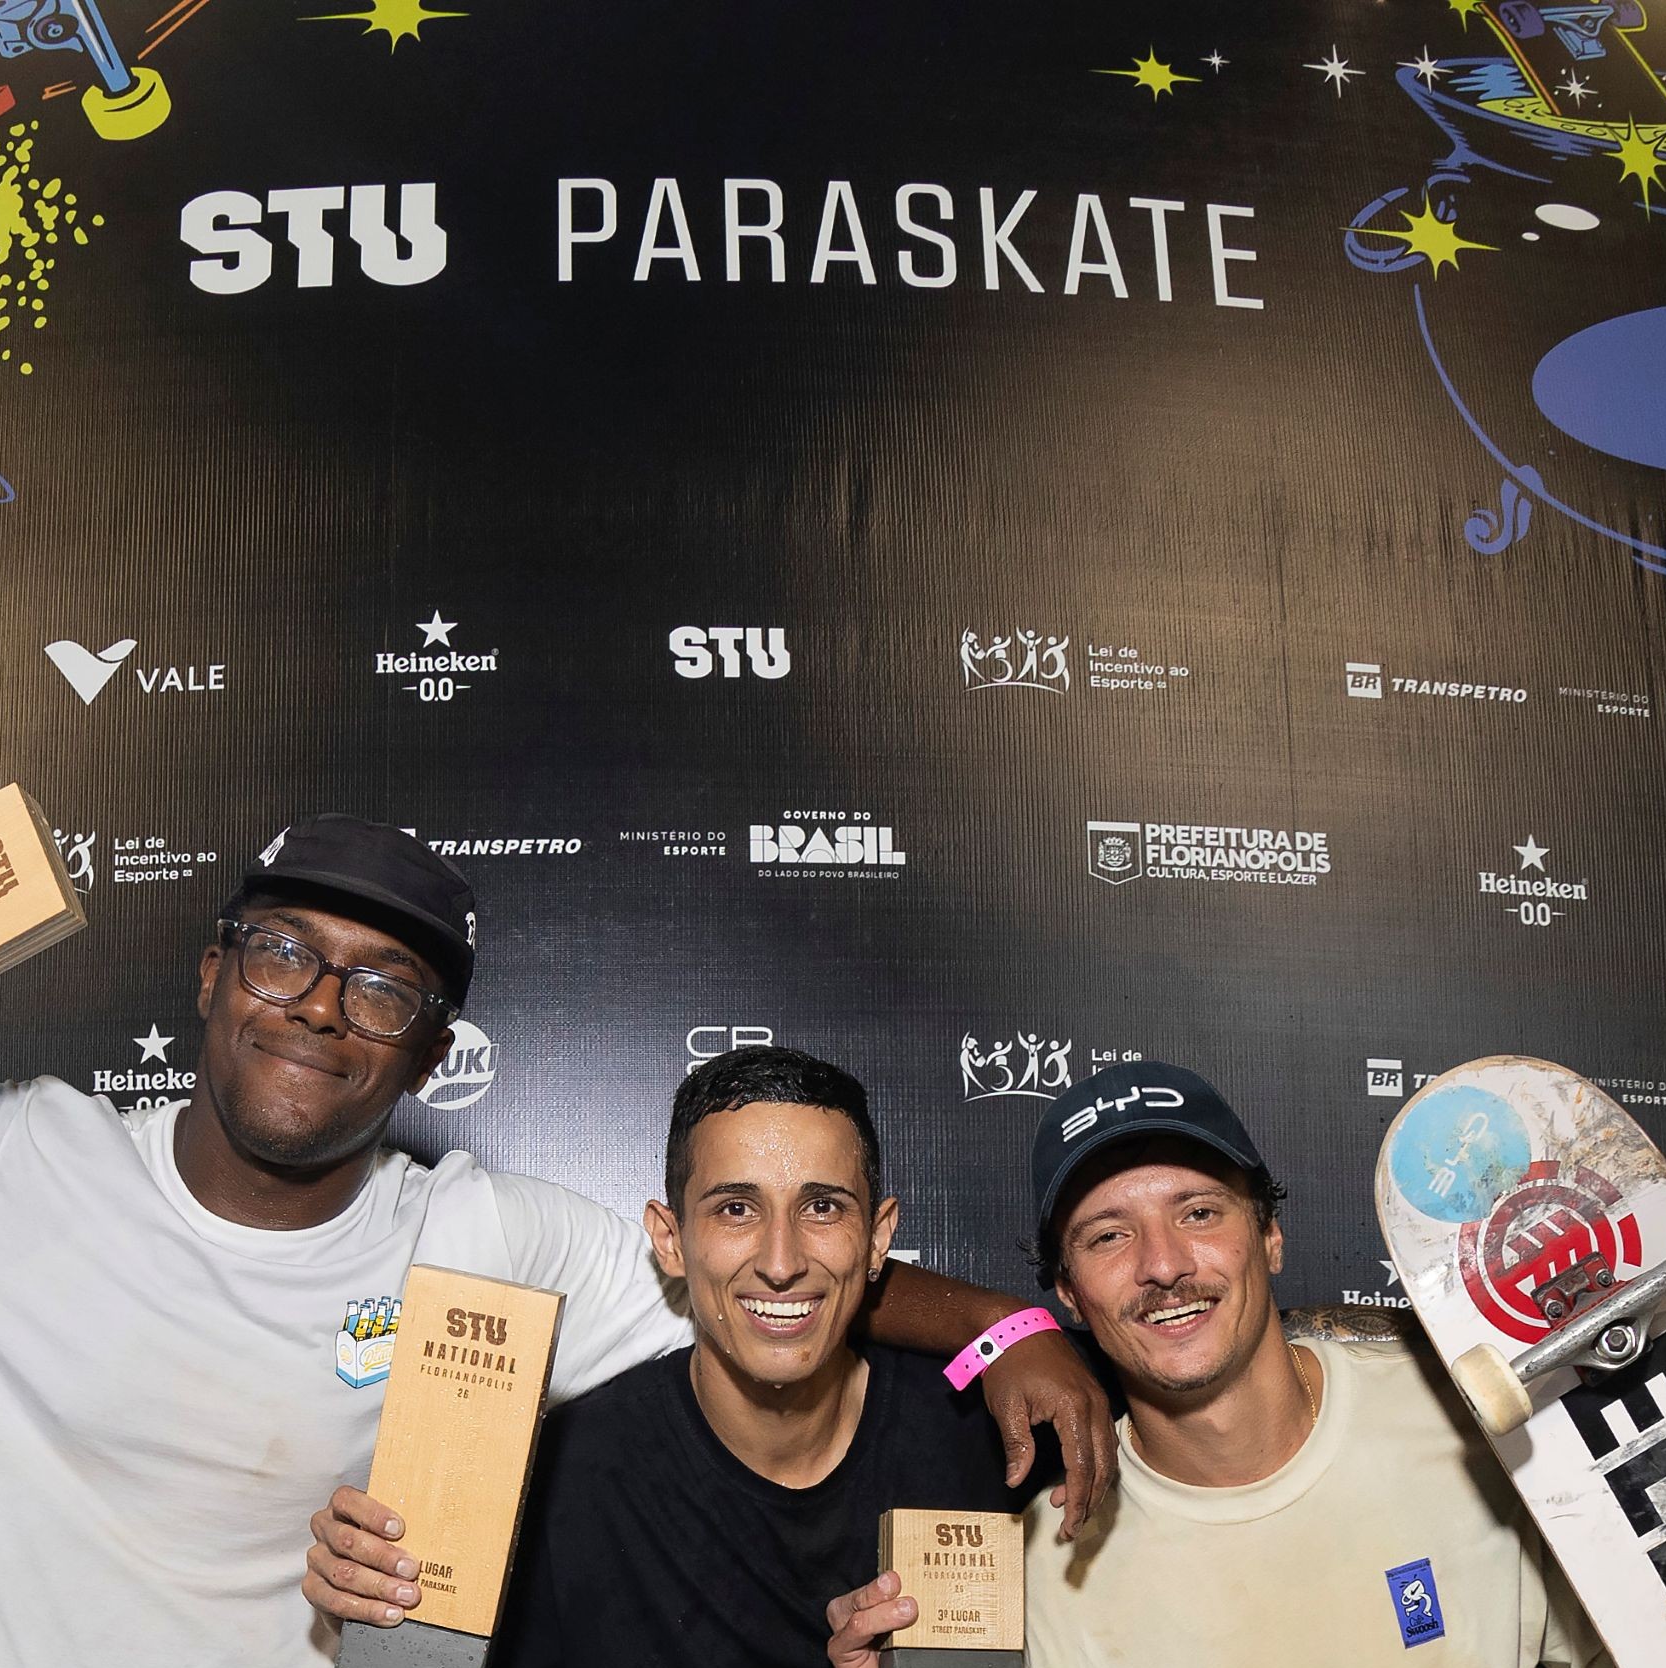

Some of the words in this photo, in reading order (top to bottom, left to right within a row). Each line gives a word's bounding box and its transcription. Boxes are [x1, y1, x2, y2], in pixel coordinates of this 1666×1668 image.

[179, 182, 448, 295] STU
[557, 176, 1264, 310] PARASKATE
[376, 647, 497, 675] Heineken
[669, 626, 790, 679] STU
[1088, 645, 1112, 658] Lei
[1117, 646, 1138, 659] de
[1089, 659, 1164, 678] Incentivo
[1169, 667, 1190, 678] ao
[136, 664, 226, 695] VALE
[1090, 674, 1154, 693] Esporte
[1349, 675, 1379, 691] BR
[1392, 677, 1528, 703] TRANSPETRO
[420, 677, 454, 702] 0.0
[1597, 704, 1650, 718] ESPORTE
[783, 810, 848, 821] GOVERNO
[854, 810, 872, 821] DO
[115, 838, 139, 850] Lei
[145, 836, 165, 849] de
[620, 829, 702, 843] MINISTÉRIO
[707, 831, 726, 842] DO
[750, 824, 905, 865] BRASIL
[1146, 823, 1288, 852] PREFEITURA
[1294, 832, 1327, 854] DE
[429, 838, 582, 857] TRANSPETRO
[663, 845, 727, 857] ESPORTE
[115, 850, 191, 867] Incentivo
[196, 851, 217, 863] ao
[1146, 845, 1331, 875] FLORIANÓPOLIS
[115, 869, 179, 885] Esporte
[758, 868, 771, 878] DO
[775, 868, 800, 878] LADO
[803, 868, 817, 878] DO
[820, 869, 845, 879] POVO
[848, 869, 900, 880] BRASILEIRO
[1147, 866, 1209, 882] CULTURA,
[1210, 870, 1265, 884] ESPORTE
[1278, 874, 1318, 886] LAZER
[1479, 871, 1587, 901] Heineken
[1519, 901, 1552, 927] 0.0
[1091, 1048, 1118, 1063] Lei
[1122, 1047, 1142, 1063] de
[1369, 1071, 1401, 1091] BR
[446, 1307, 507, 1347] STU
[423, 1340, 517, 1375] NATIONAL
[419, 1363, 513, 1392] FLORIANÓPOLIS
[457, 1387, 470, 1400] 26
[935, 1523, 984, 1548] STU
[419, 1558, 453, 1580] LUGAR
[923, 1552, 996, 1568] NATIONAL
[420, 1577, 457, 1594] PARASKATE
[951, 1609, 981, 1623] LUGAR
[931, 1625, 952, 1634] STREET
[953, 1625, 987, 1635] PARASKATE
